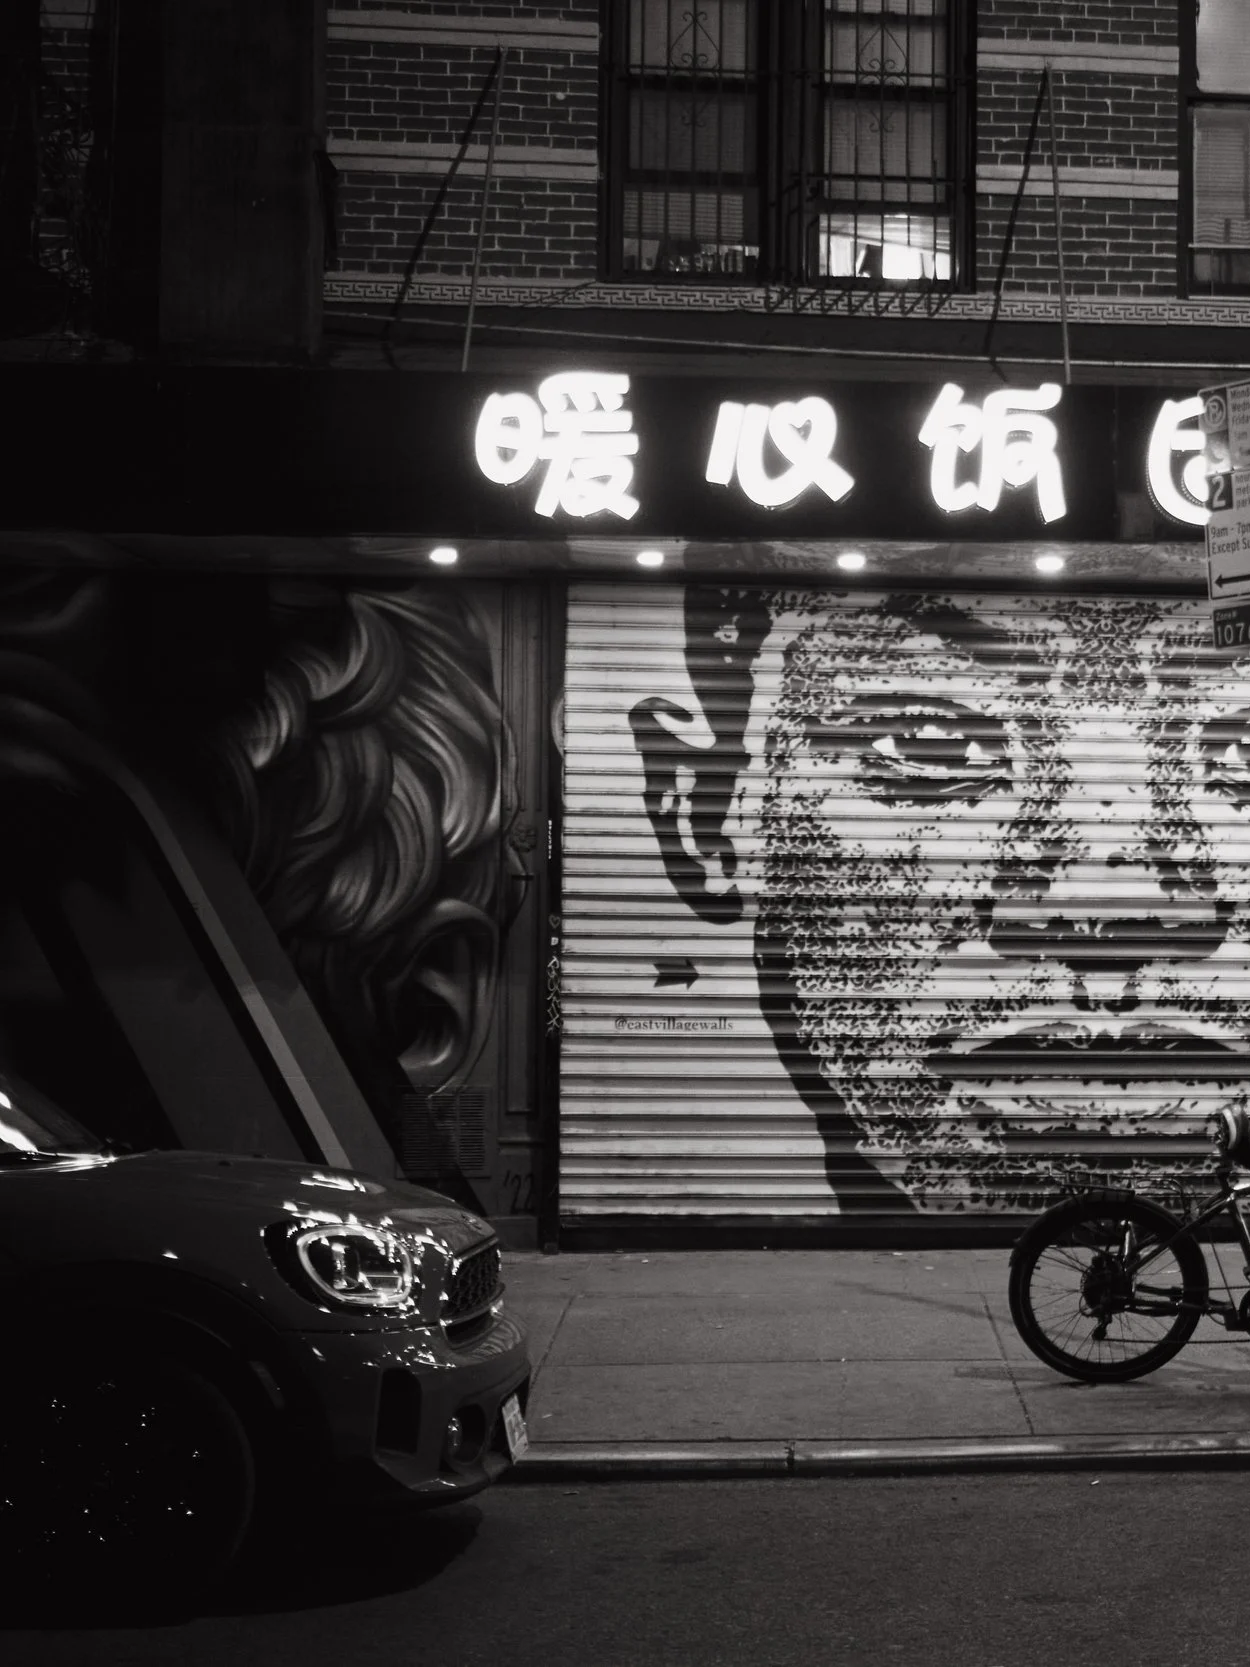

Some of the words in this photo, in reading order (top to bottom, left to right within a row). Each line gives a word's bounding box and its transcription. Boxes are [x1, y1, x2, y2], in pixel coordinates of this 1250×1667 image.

[1212, 475, 1226, 508] 2
[1211, 526, 1228, 538] 9am
[1211, 540, 1240, 555] Except
